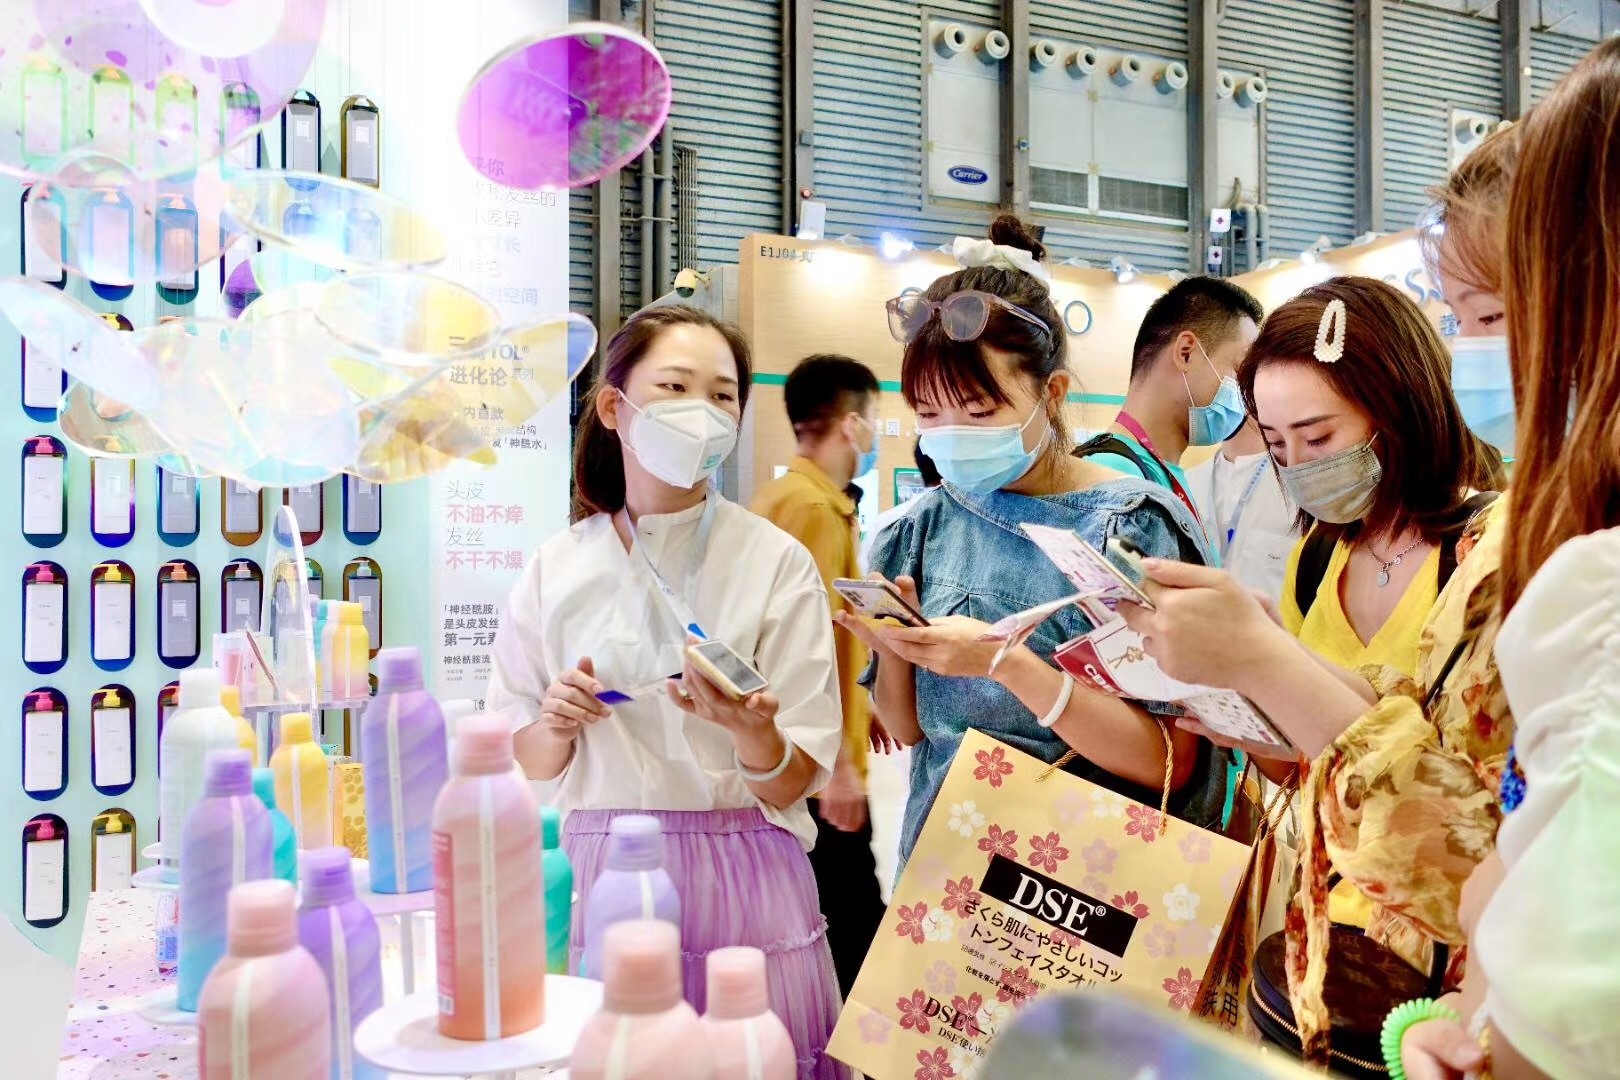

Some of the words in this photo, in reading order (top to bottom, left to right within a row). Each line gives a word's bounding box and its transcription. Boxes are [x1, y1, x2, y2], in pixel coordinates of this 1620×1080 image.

[952, 169, 984, 181] Carrier
[447, 504, 524, 525] 不油不痒
[964, 899, 1123, 982] さくら肌にやさしいコッ
